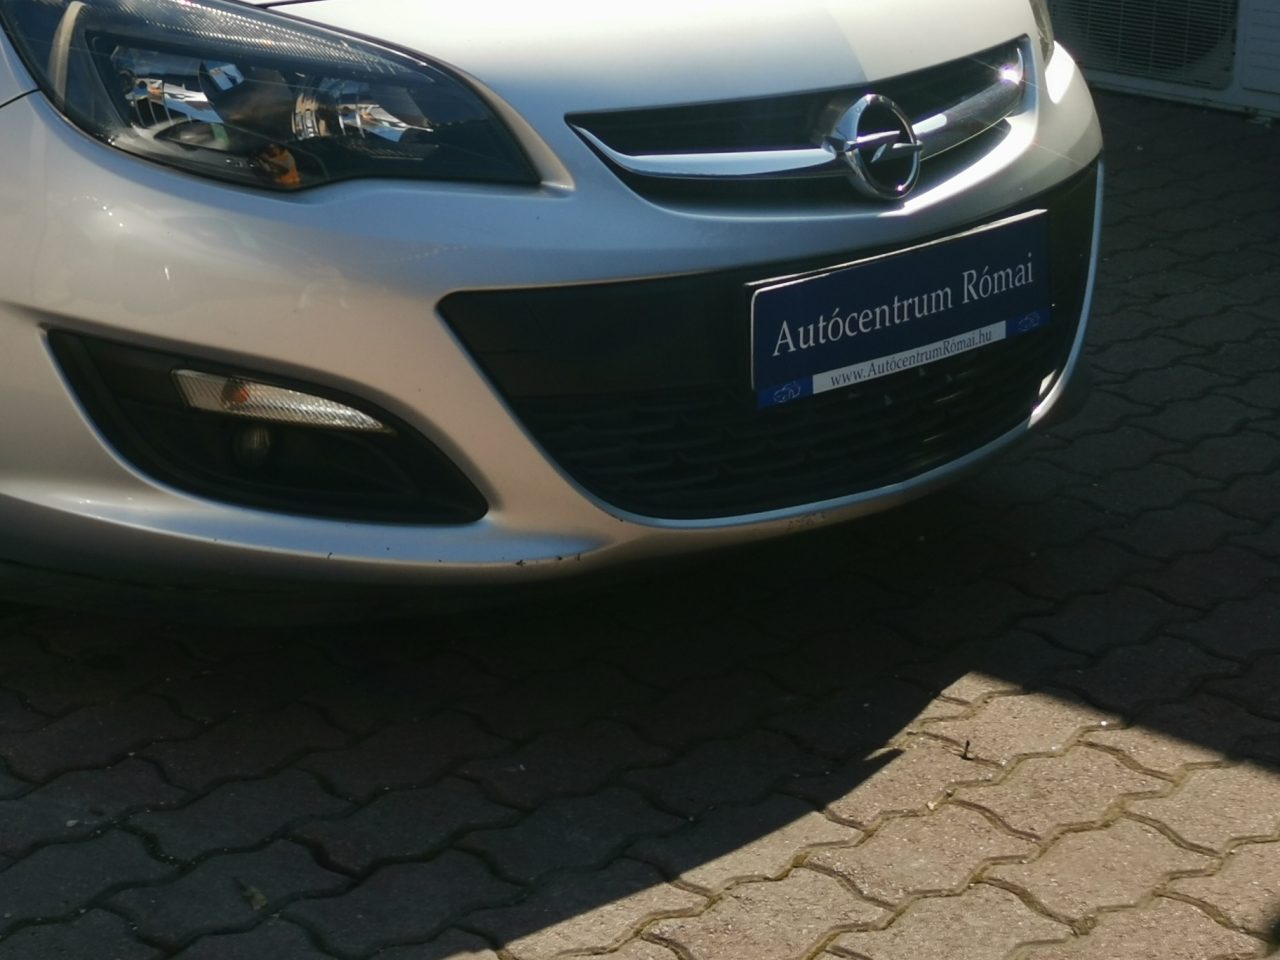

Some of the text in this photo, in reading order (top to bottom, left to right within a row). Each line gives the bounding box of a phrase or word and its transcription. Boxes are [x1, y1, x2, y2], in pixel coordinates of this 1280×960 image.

[772, 251, 1034, 357] Autócentrum Római
[830, 328, 993, 389] www.AutócentrumRómai.hu
